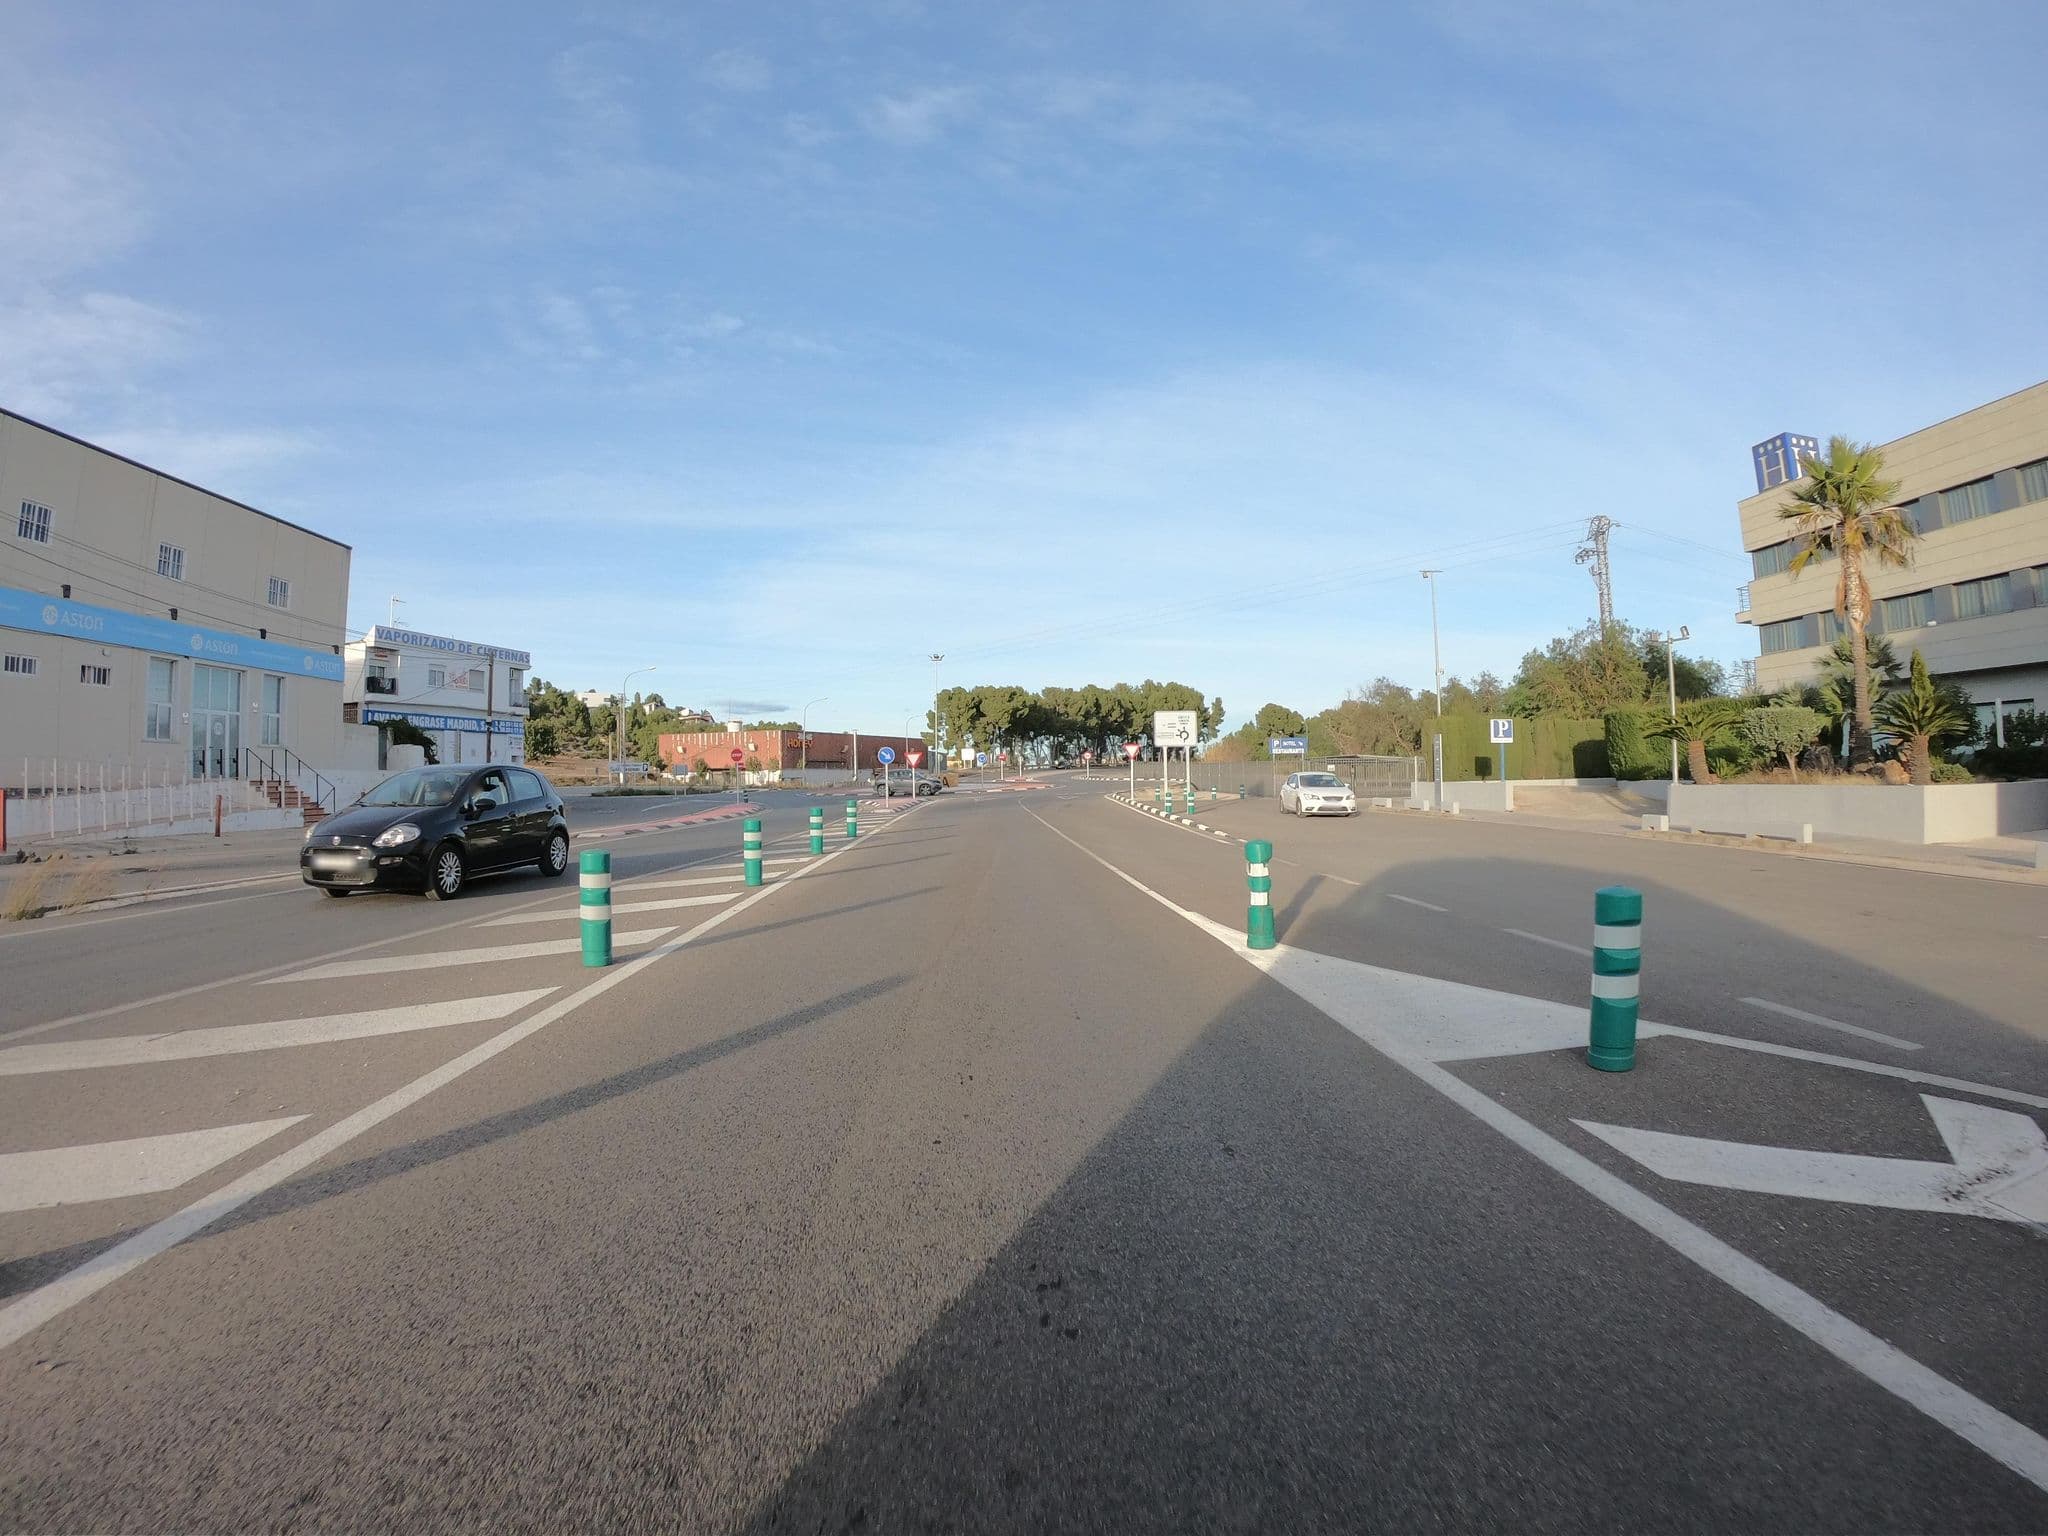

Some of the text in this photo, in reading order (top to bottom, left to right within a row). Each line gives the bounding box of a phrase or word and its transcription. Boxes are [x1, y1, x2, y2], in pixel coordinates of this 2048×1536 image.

[1758, 448, 1789, 490] H
[376, 627, 455, 651] VAPORIZADO
[458, 643, 473, 655] DE
[407, 714, 446, 729] ENGRASE
[1497, 719, 1509, 738] P
